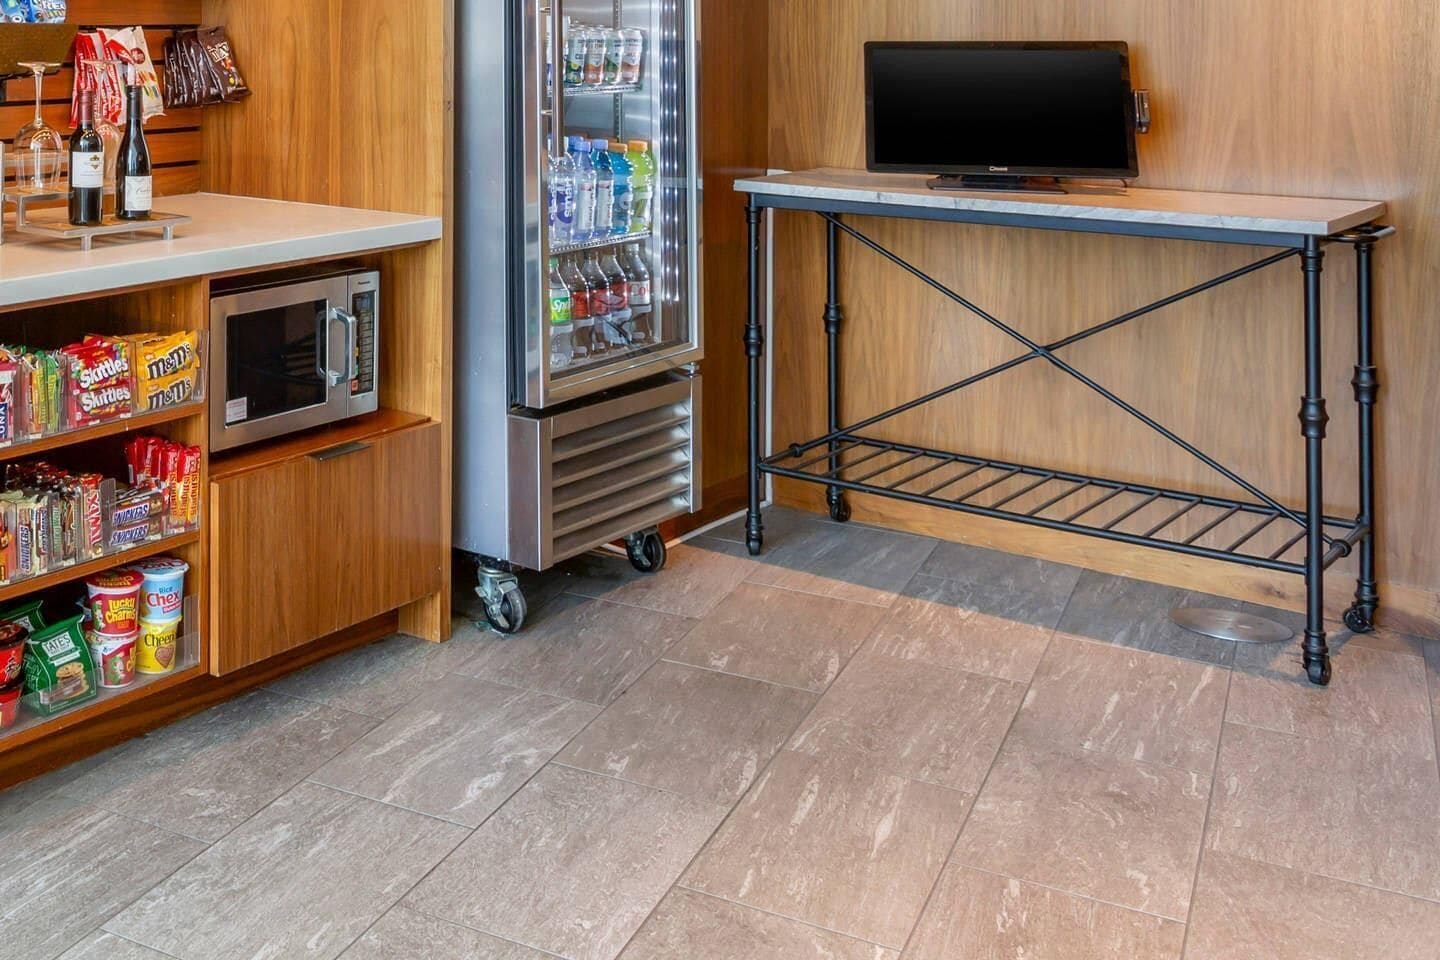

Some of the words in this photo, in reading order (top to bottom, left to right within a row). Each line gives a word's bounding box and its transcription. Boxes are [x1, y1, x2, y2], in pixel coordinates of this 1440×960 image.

[80, 357, 129, 389] Skittles
[80, 386, 132, 413] Skittles
[113, 504, 149, 524] SNICKERS
[111, 525, 148, 543] SNICKERS
[146, 589, 180, 608] Chex
